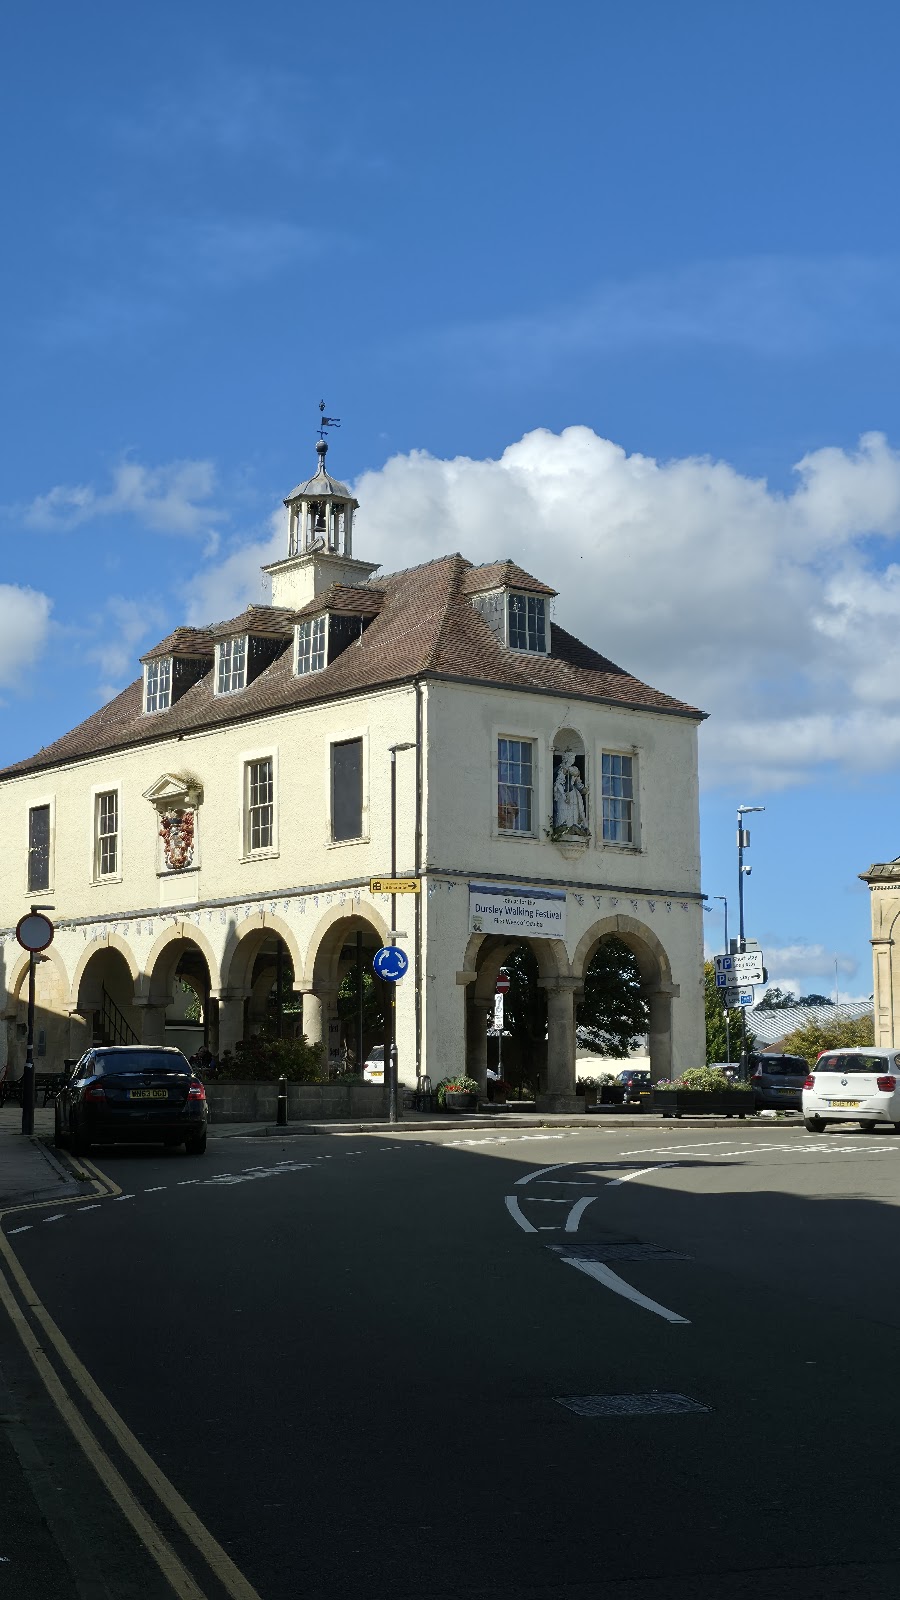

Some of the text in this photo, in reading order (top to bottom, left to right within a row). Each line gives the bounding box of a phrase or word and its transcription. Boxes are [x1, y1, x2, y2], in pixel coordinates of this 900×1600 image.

[476, 904, 562, 920] Dursley Walking Festival
